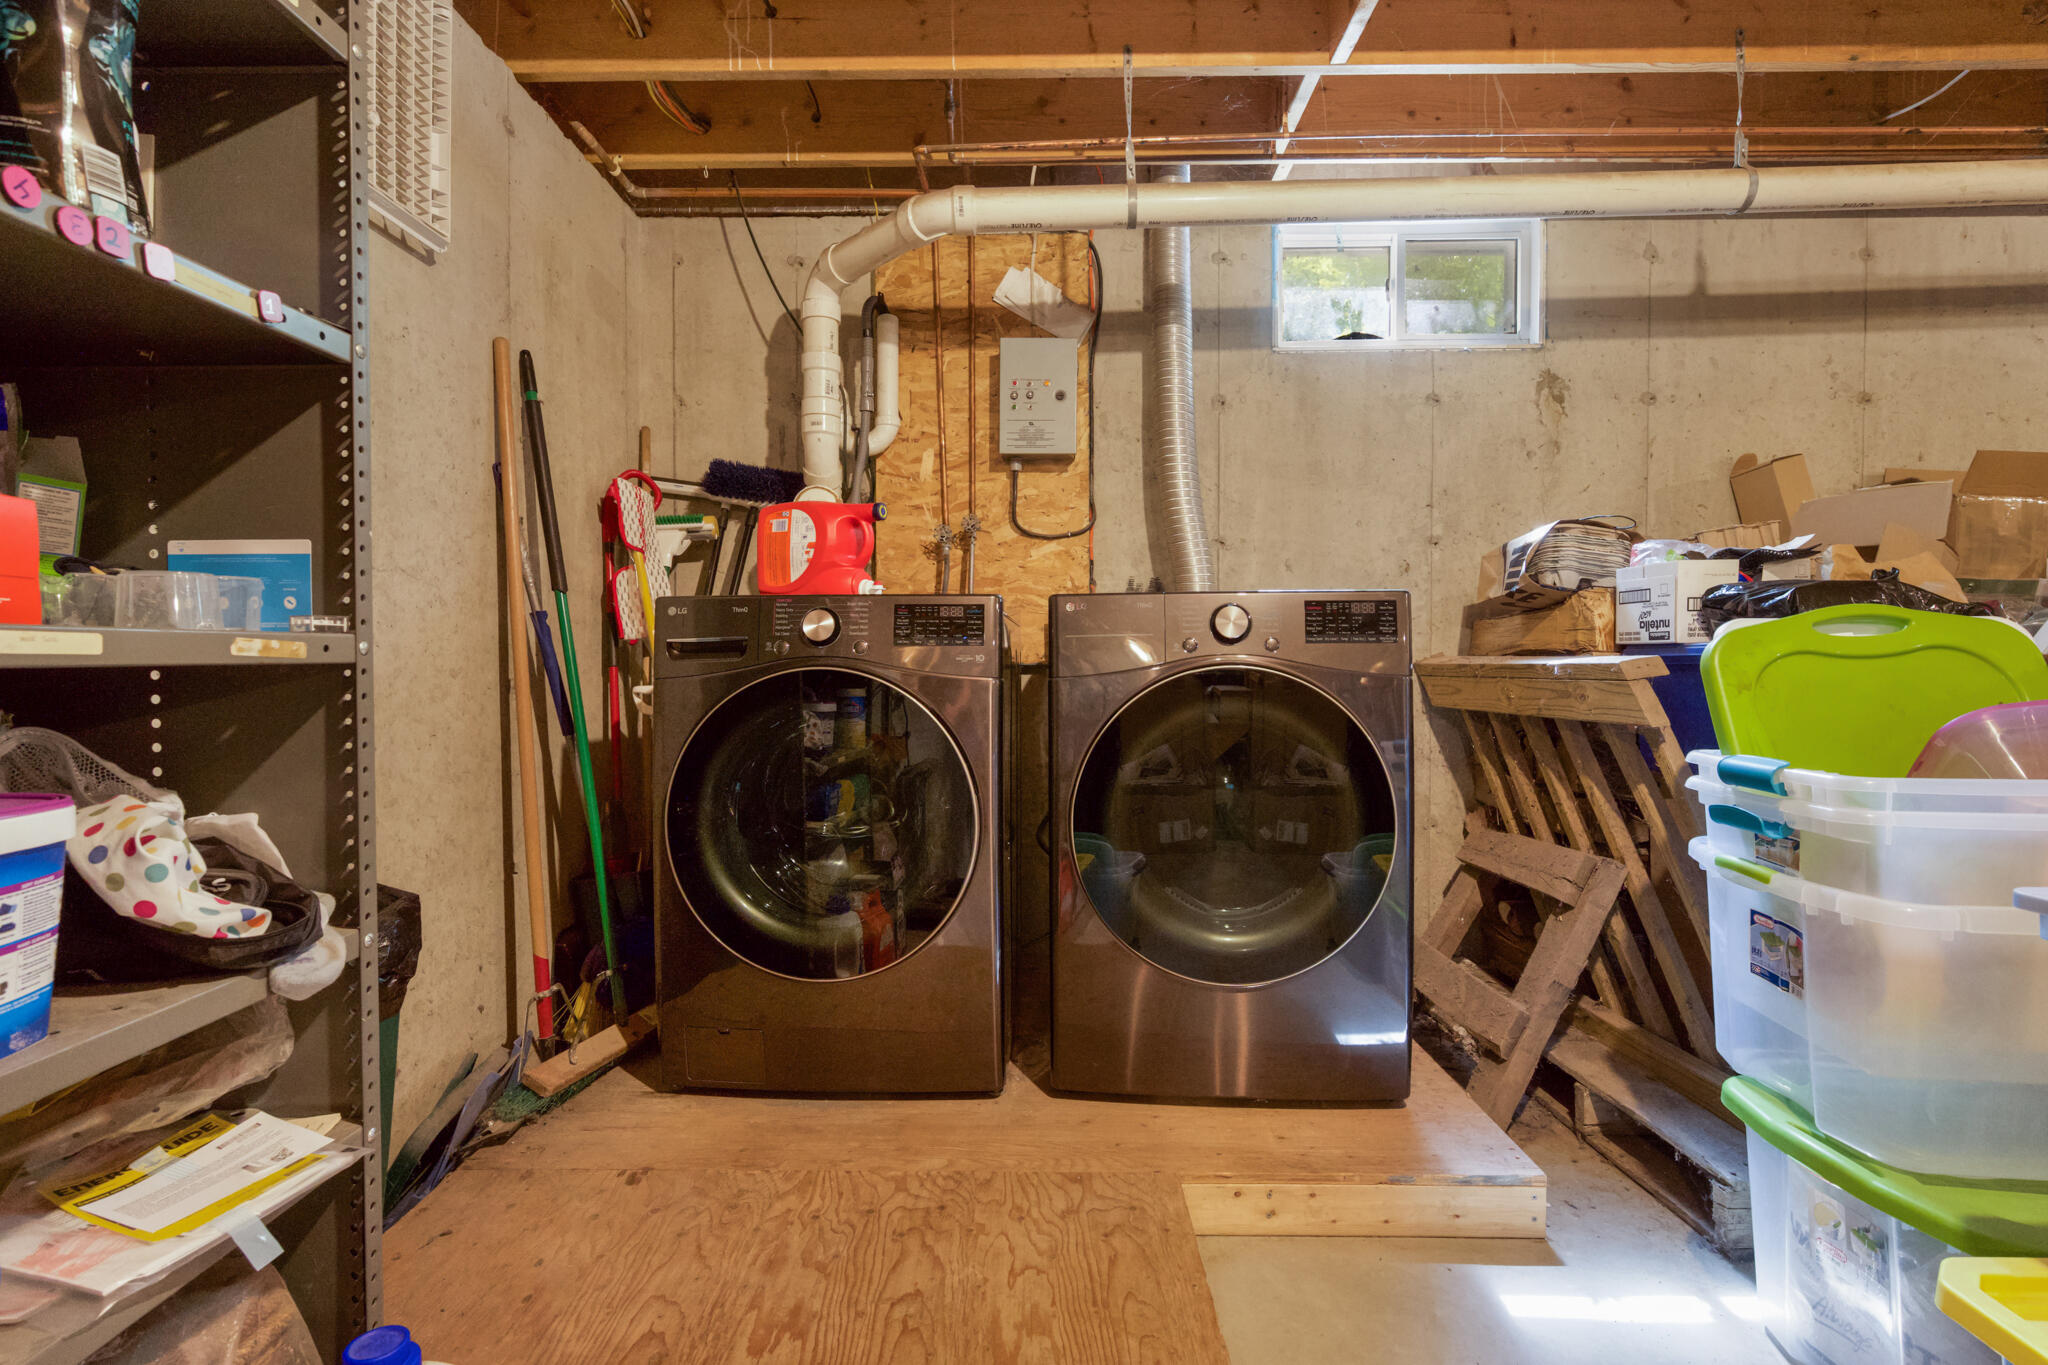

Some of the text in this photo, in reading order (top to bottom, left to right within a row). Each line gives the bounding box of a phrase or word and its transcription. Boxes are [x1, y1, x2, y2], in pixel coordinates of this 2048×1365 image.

[105, 226, 121, 249] 2
[264, 298, 275, 315] 1
[1639, 619, 1670, 632] nutella
[162, 1120, 219, 1151] UIDE
